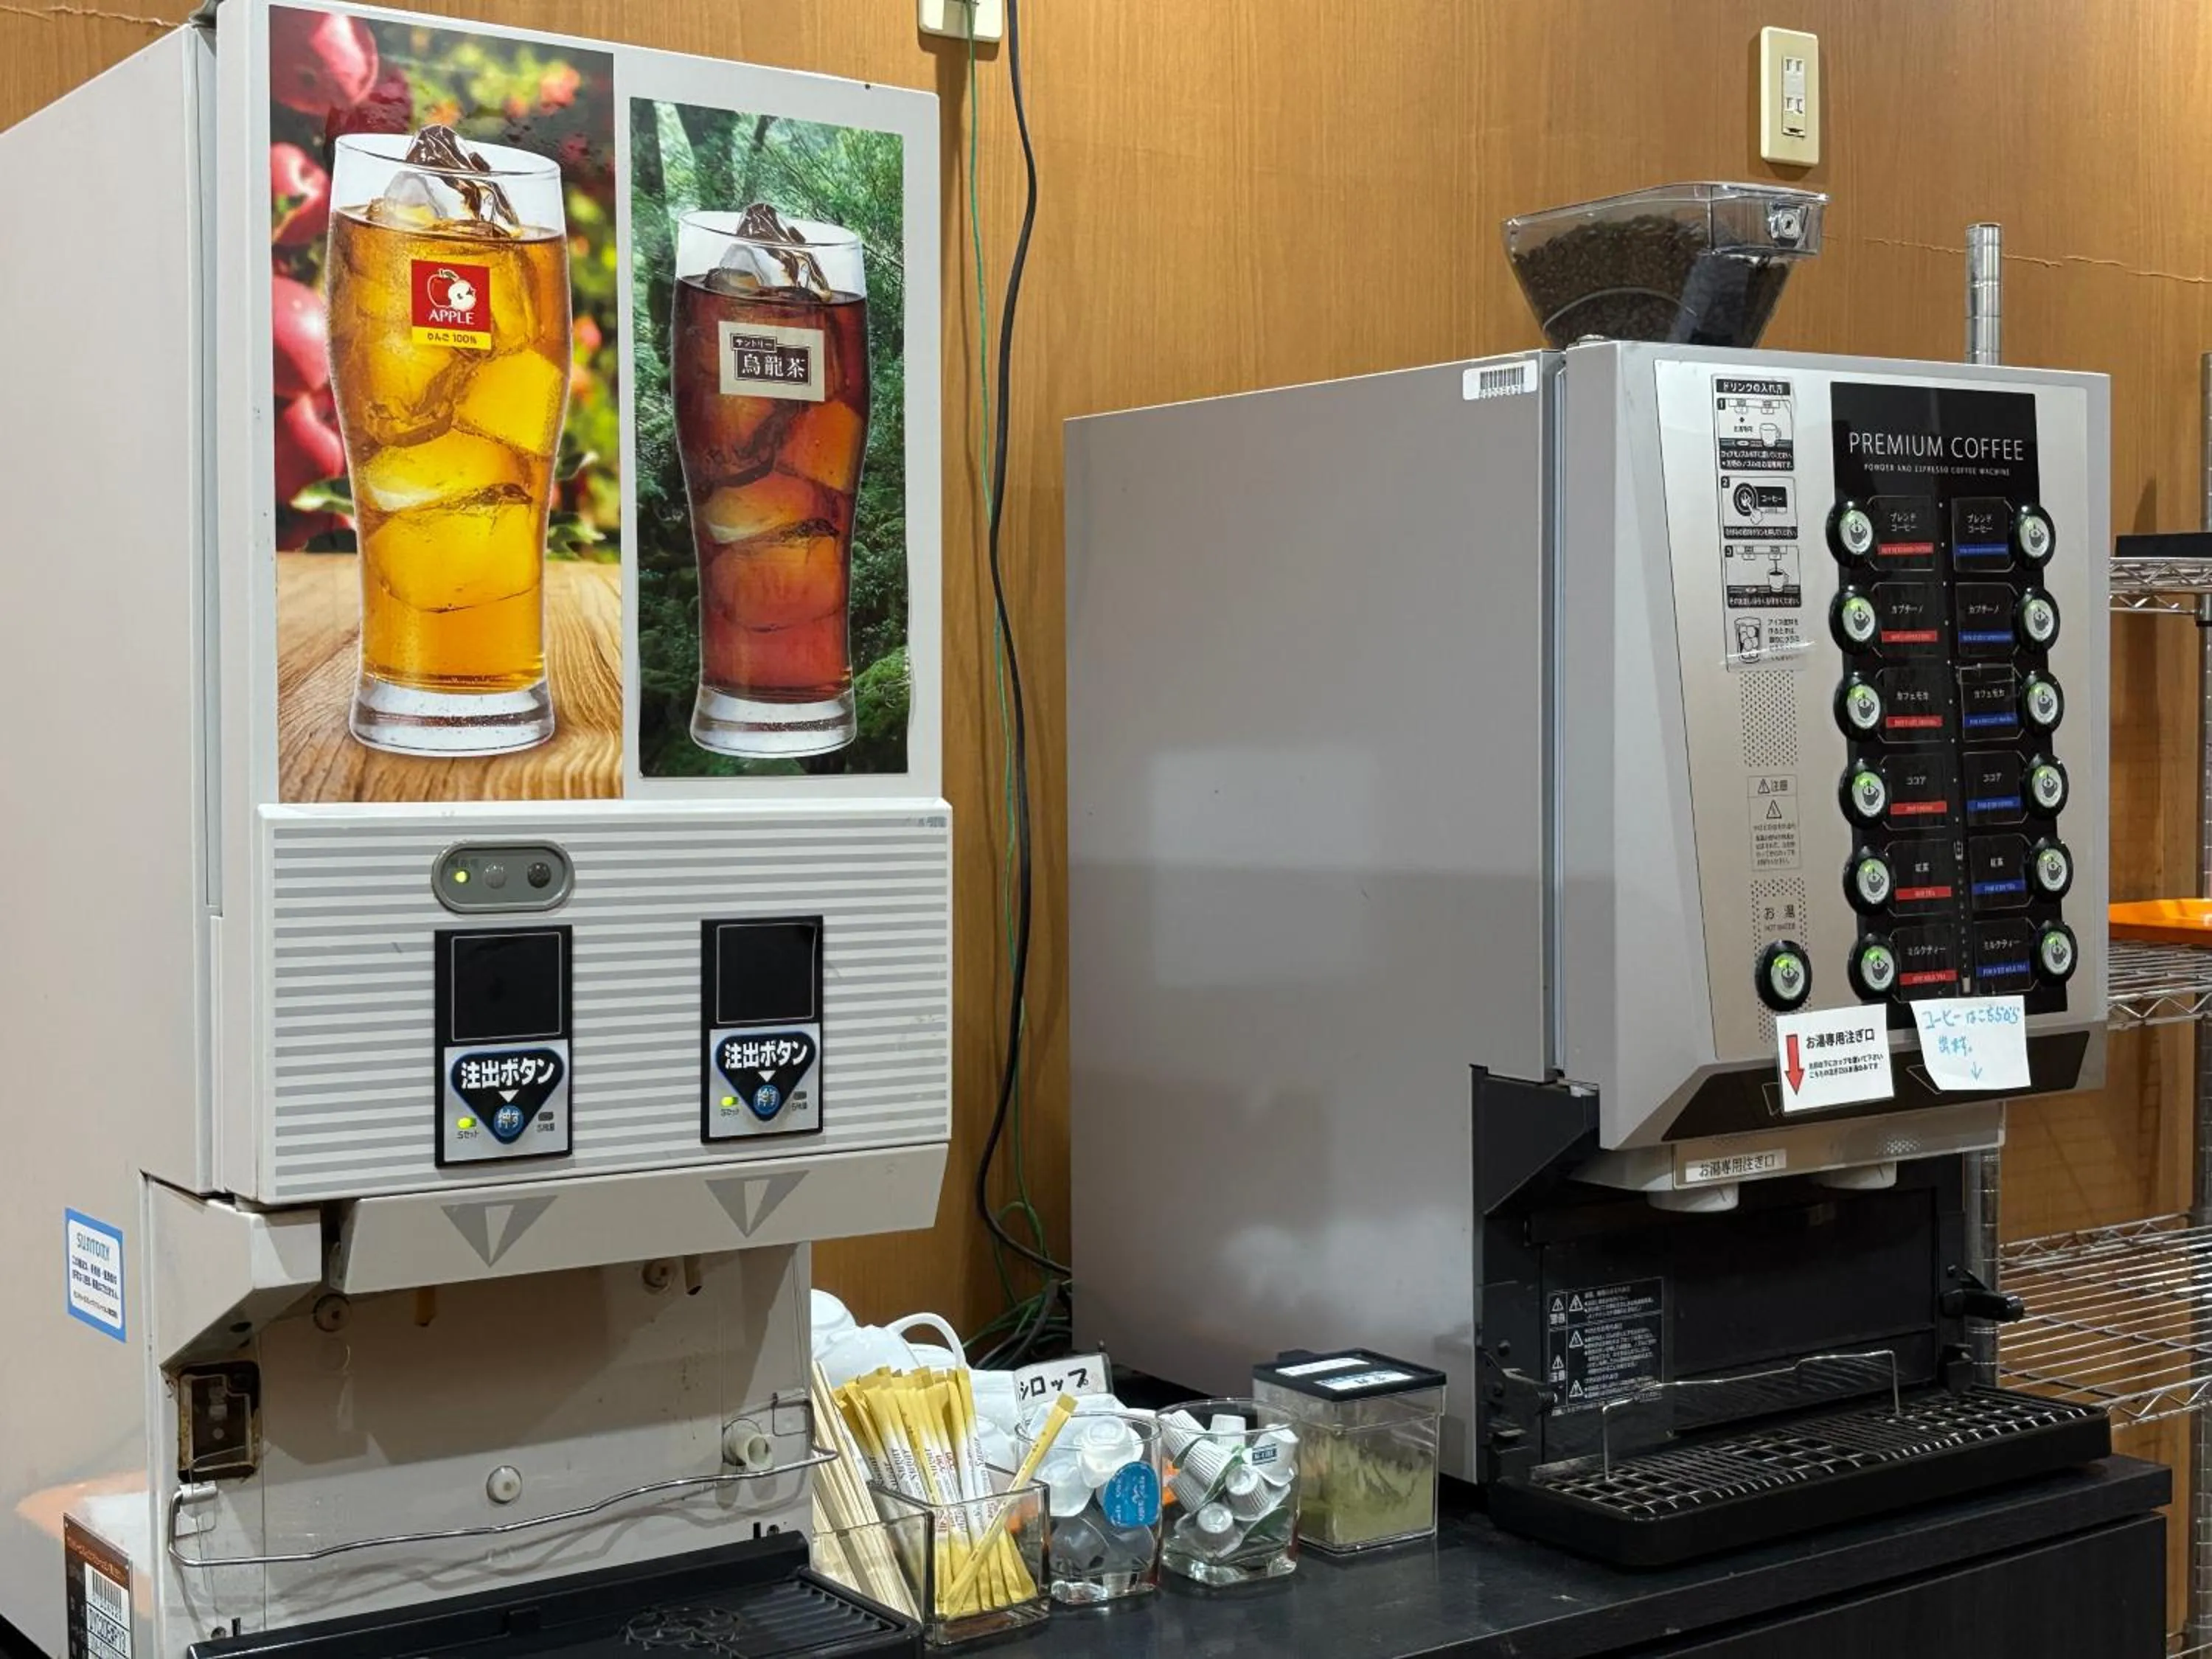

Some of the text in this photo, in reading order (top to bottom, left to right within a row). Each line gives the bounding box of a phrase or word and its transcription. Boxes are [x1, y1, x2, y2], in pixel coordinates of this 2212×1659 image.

[428, 309, 476, 325] APPLE
[453, 333, 478, 345] 100%
[735, 338, 773, 349] サントリー
[742, 353, 806, 378] 烏龍茶
[1848, 432, 2025, 462] PREMIUM COFFEE
[1890, 512, 1917, 523] ブレンド
[1967, 512, 1992, 524] ブレンド
[1891, 524, 1917, 532] コーヒー
[1968, 524, 1993, 534] コーヒー
[1906, 776, 1927, 786] ココア
[1983, 772, 2003, 783] ココア
[1806, 1029, 1875, 1049] お湯専用注ぎ口
[725, 1040, 808, 1069] 注出ボタン
[461, 1057, 555, 1090] 注出ボタン
[1699, 1154, 1775, 1178] お湯専用注ぎ口
[1020, 1367, 1089, 1401] シロップ
